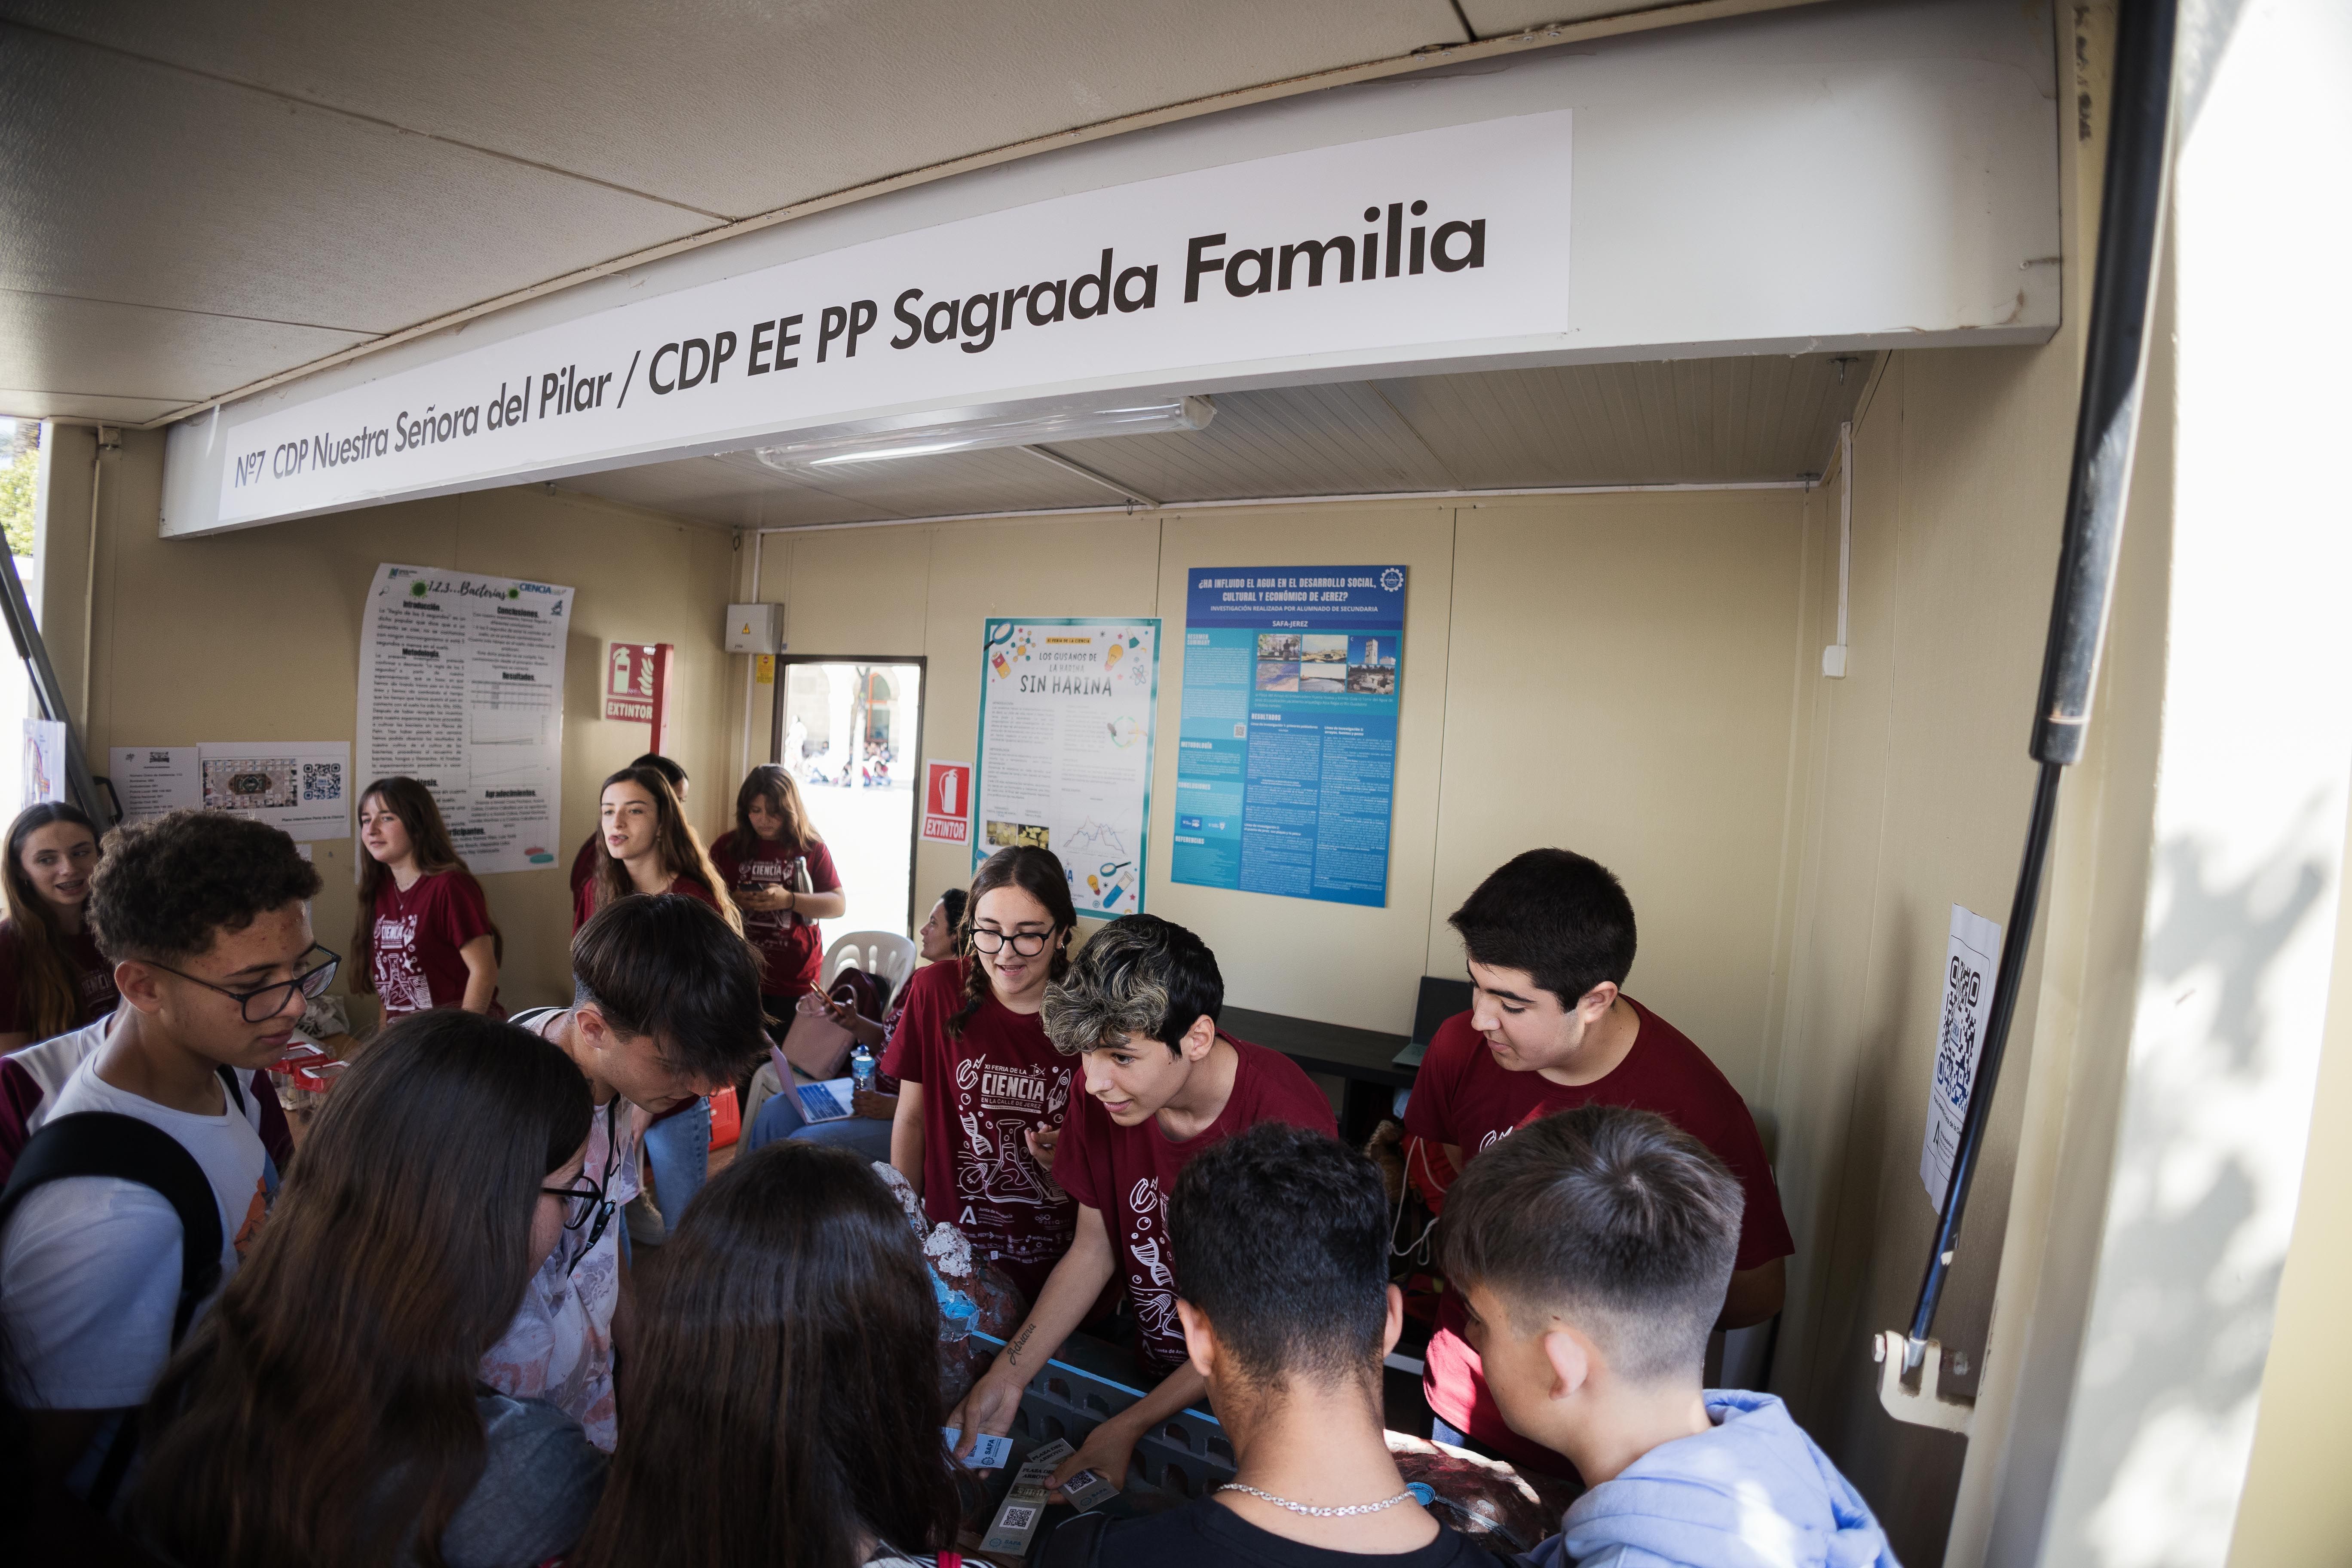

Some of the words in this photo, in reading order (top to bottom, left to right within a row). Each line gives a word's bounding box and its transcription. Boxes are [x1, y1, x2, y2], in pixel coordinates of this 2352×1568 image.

[235, 449, 266, 488] Nº7
[273, 438, 308, 480] CDP
[313, 426, 389, 471] Nuestra
[395, 403, 479, 452] Señora
[487, 376, 531, 431] del
[539, 356, 612, 419] Pilar
[616, 350, 641, 409] /
[649, 331, 737, 395] CDP
[747, 313, 803, 377] EE
[817, 300, 878, 364] PP
[890, 247, 1158, 354] Sagrada
[1184, 199, 1486, 303] Familia
[1198, 579, 1213, 589] ¿HA
[1214, 579, 1245, 588] INFLUIDO
[1246, 579, 1255, 588] EL
[1256, 578, 1275, 588] AGUA
[1277, 578, 1287, 588] EN
[1289, 578, 1297, 588] EL
[1299, 578, 1345, 588] DESARROLLO
[1348, 578, 1377, 589] SOCIAL,
[1222, 591, 1256, 602] CULTURAL
[1259, 592, 1263, 601] Y
[1265, 590, 1307, 601] ECONÓMICO
[1309, 592, 1319, 601] DE
[1320, 591, 1348, 602] JEREZ?
[1039, 652, 1052, 661] LOS
[1054, 652, 1087, 662] GUSANOS
[1089, 653, 1097, 662] DE
[1049, 664, 1057, 673] LA
[1059, 664, 1084, 673] HARINA
[1020, 674, 1047, 693] SIN
[1052, 675, 1112, 697] HARINA
[607, 701, 653, 720] EXTINTOR
[1251, 713, 1281, 721] RESULTADOS
[925, 818, 965, 839] EXTINTOR
[752, 864, 781, 876] CIENCIA
[981, 1073, 1044, 1102] CIENCIA
[1007, 1323, 1036, 1366] Adriana
[984, 1439, 995, 1455] SAFA
[1032, 1449, 1051, 1461] PLAZA
